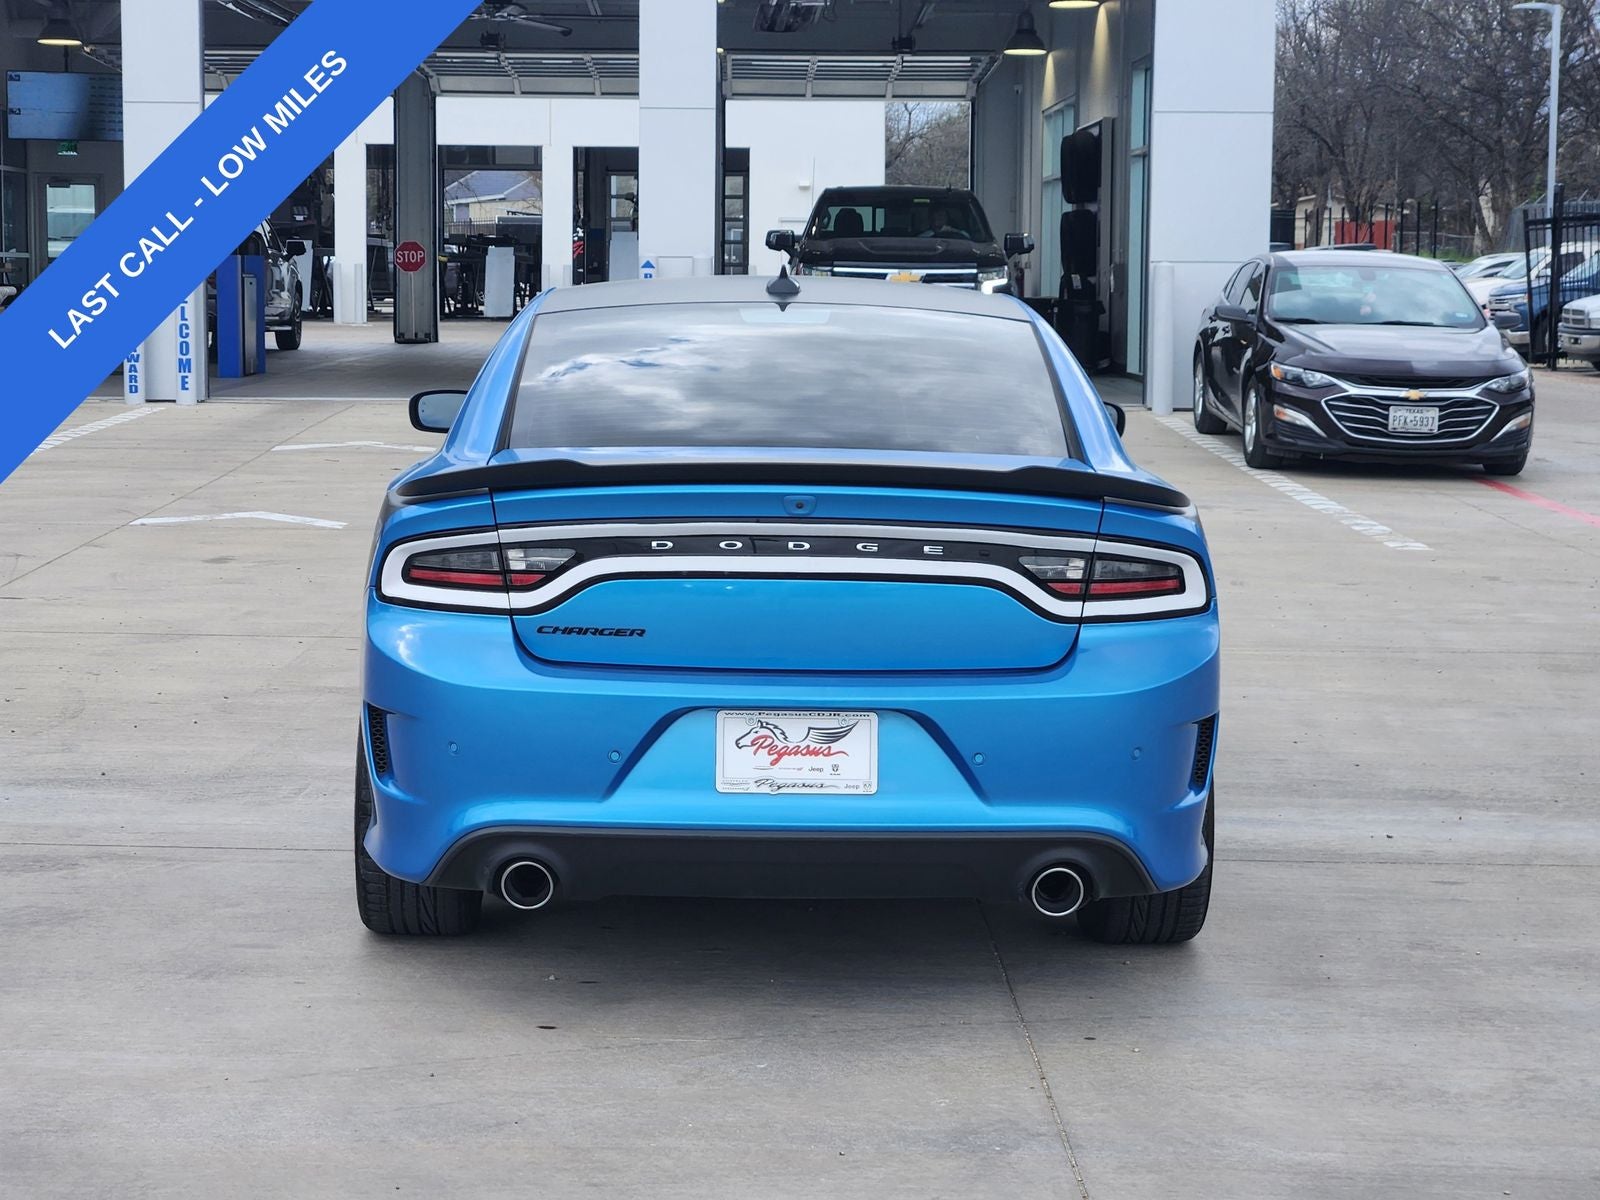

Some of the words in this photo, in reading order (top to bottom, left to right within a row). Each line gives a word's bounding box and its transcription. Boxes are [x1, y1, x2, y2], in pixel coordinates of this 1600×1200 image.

[396, 250, 424, 263] STOP
[536, 625, 646, 637] CHARGER
[751, 735, 849, 766] Pegasus
[754, 778, 840, 792] Pegasus
